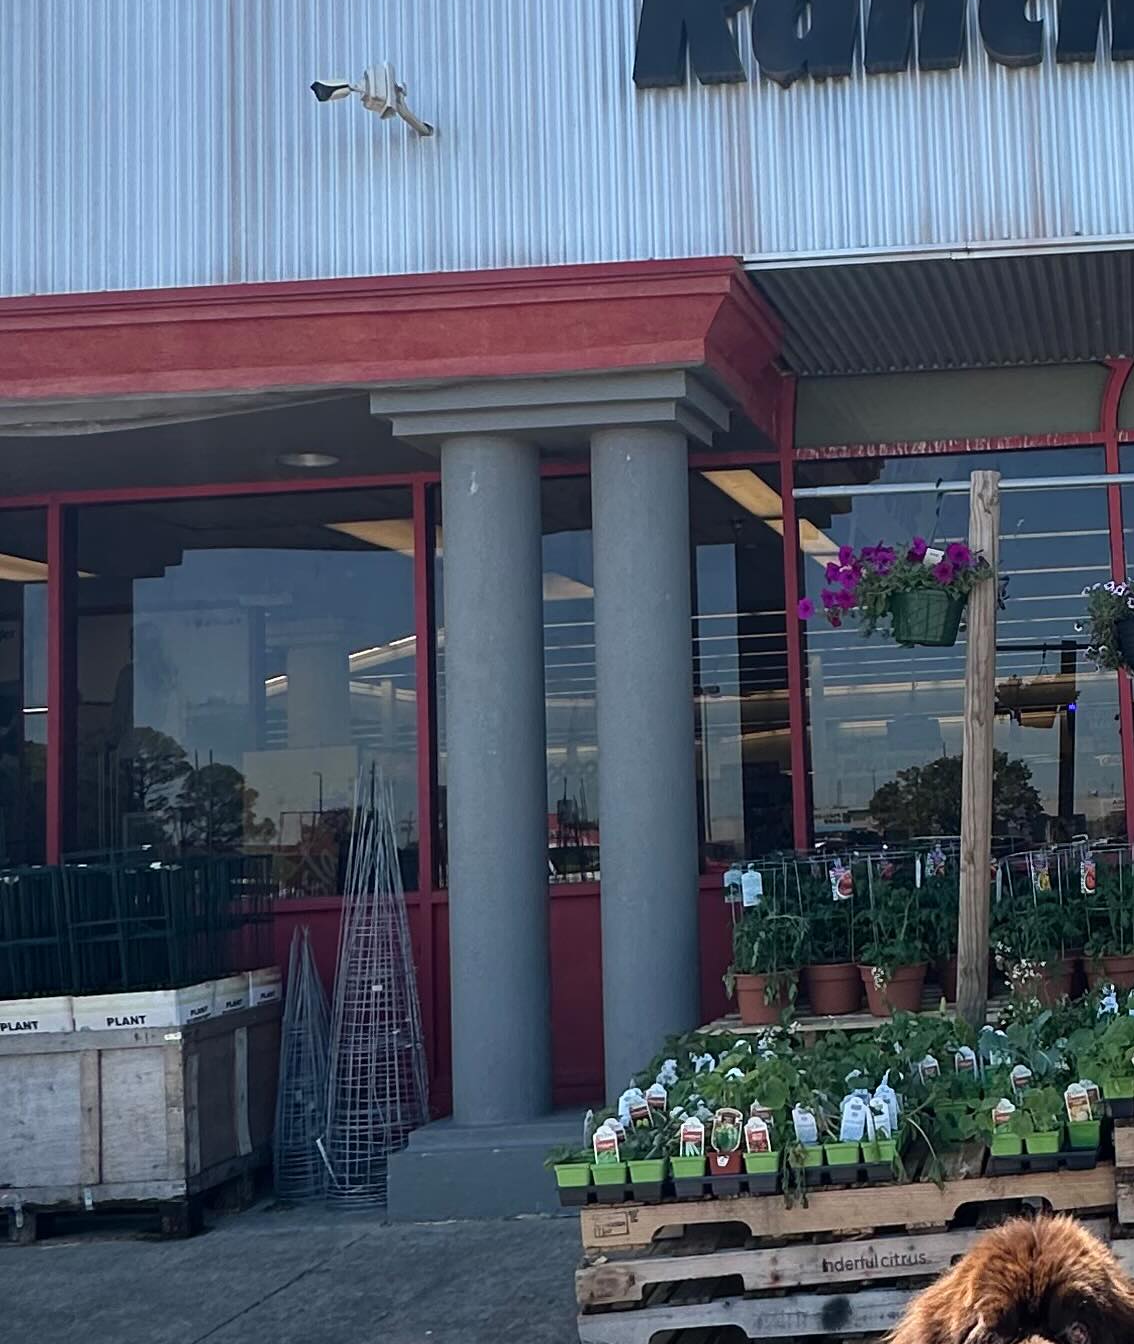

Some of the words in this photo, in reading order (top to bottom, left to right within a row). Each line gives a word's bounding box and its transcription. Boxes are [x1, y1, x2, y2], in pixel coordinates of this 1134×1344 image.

[0, 1021, 38, 1032] PLANT
[107, 1015, 146, 1027] PLANT
[881, 1251, 927, 1268] citrus
